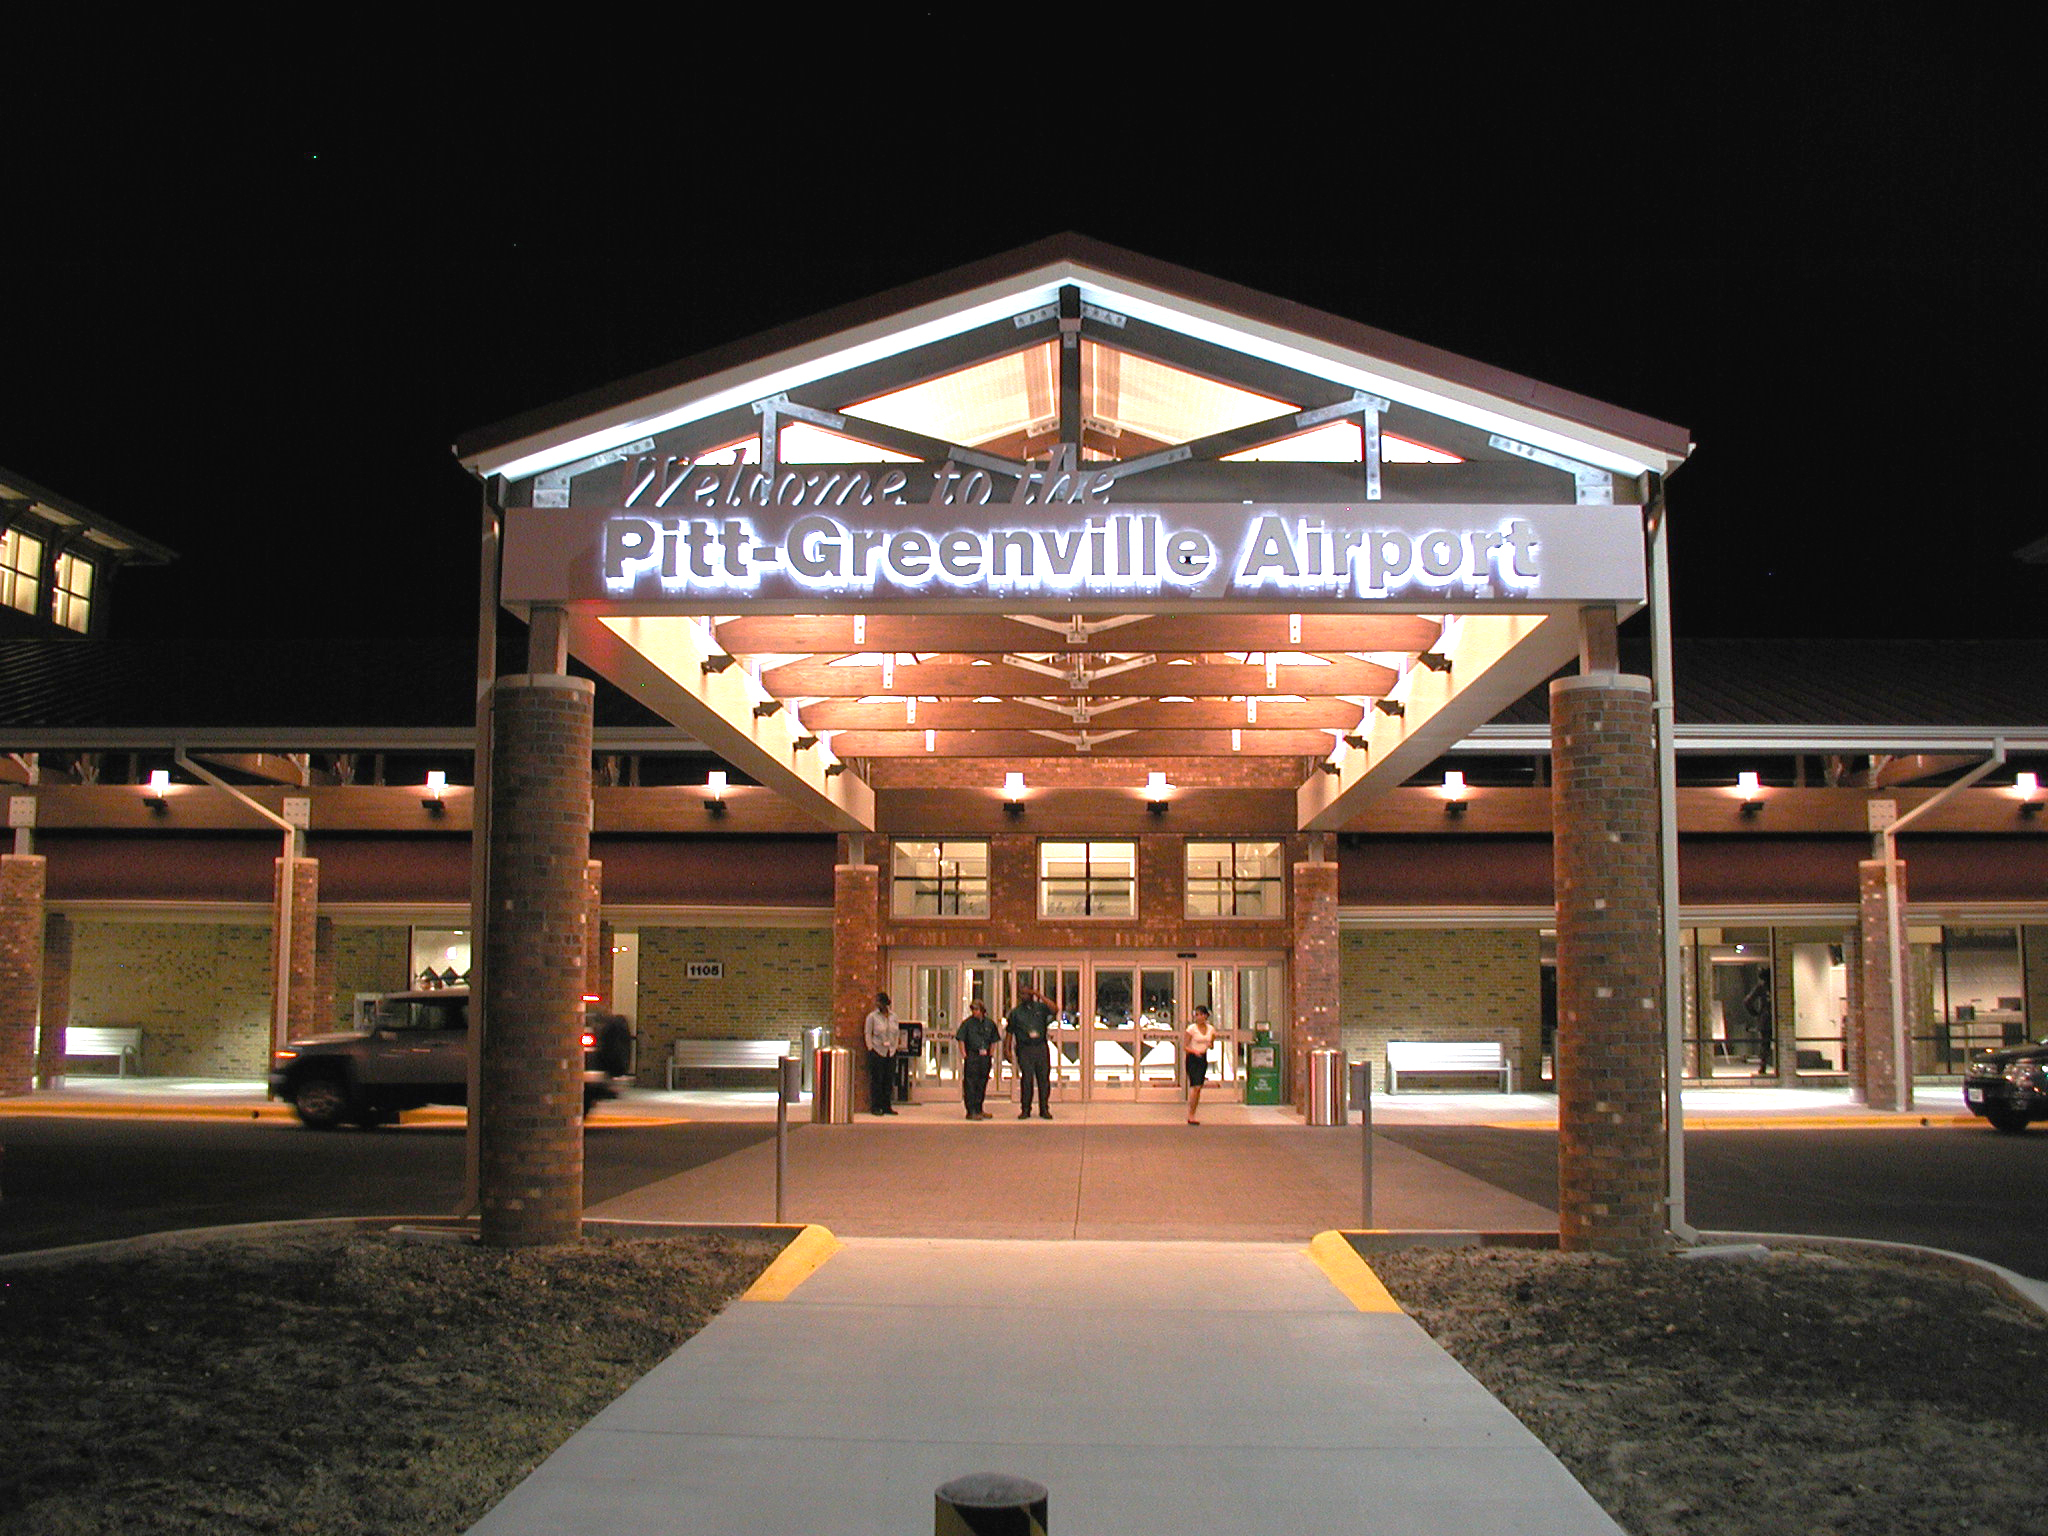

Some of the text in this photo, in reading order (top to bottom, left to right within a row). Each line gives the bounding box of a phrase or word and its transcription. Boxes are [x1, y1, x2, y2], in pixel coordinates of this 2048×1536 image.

[619, 443, 1115, 507] Welcome to the
[604, 516, 1541, 589] Pitt-Greenville Airport
